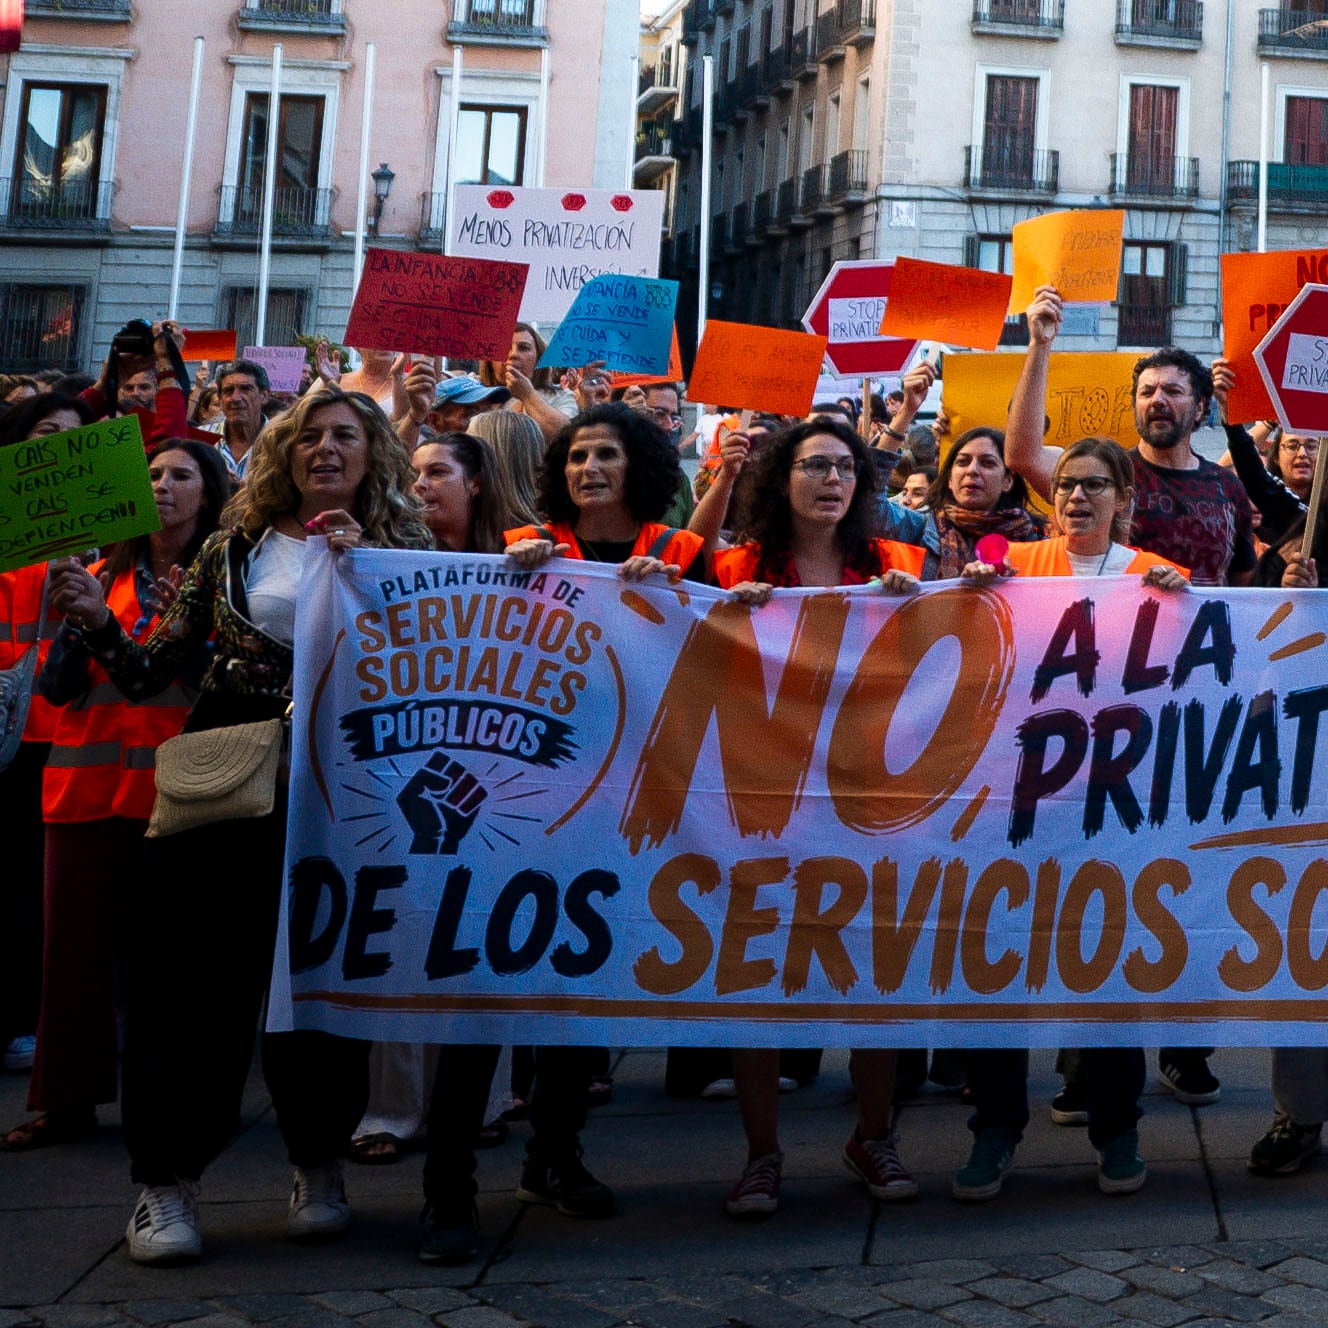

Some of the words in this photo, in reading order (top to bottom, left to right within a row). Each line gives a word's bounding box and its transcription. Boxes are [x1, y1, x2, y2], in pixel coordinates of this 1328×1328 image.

[458, 212, 513, 248] MENOS
[523, 218, 635, 251] PRIVATIZACIÓN
[371, 253, 390, 272] LA
[381, 281, 407, 298] NO
[586, 302, 600, 316] SE
[607, 302, 652, 322] VENDE
[618, 329, 633, 347] Y
[561, 347, 583, 365] SE
[587, 348, 658, 370] DEFIENDE
[14, 441, 58, 469] CAIS
[67, 431, 101, 457] NO
[106, 424, 131, 447] SE
[8, 461, 94, 496] VENDEN
[26, 492, 69, 517] CAIS
[86, 480, 116, 500] SE
[379, 562, 547, 603] PLATAFORMA
[551, 578, 586, 609] DE
[355, 592, 602, 666] SERVICIOS
[356, 646, 588, 716] SOCIALES
[371, 702, 547, 757] PÚBLICOS
[619, 585, 1016, 857] NO
[1030, 597, 1099, 704] A
[1120, 596, 1236, 690] LA
[285, 856, 409, 982] DE
[423, 864, 621, 981] LOS
[632, 852, 1193, 997] SERVICIOS
